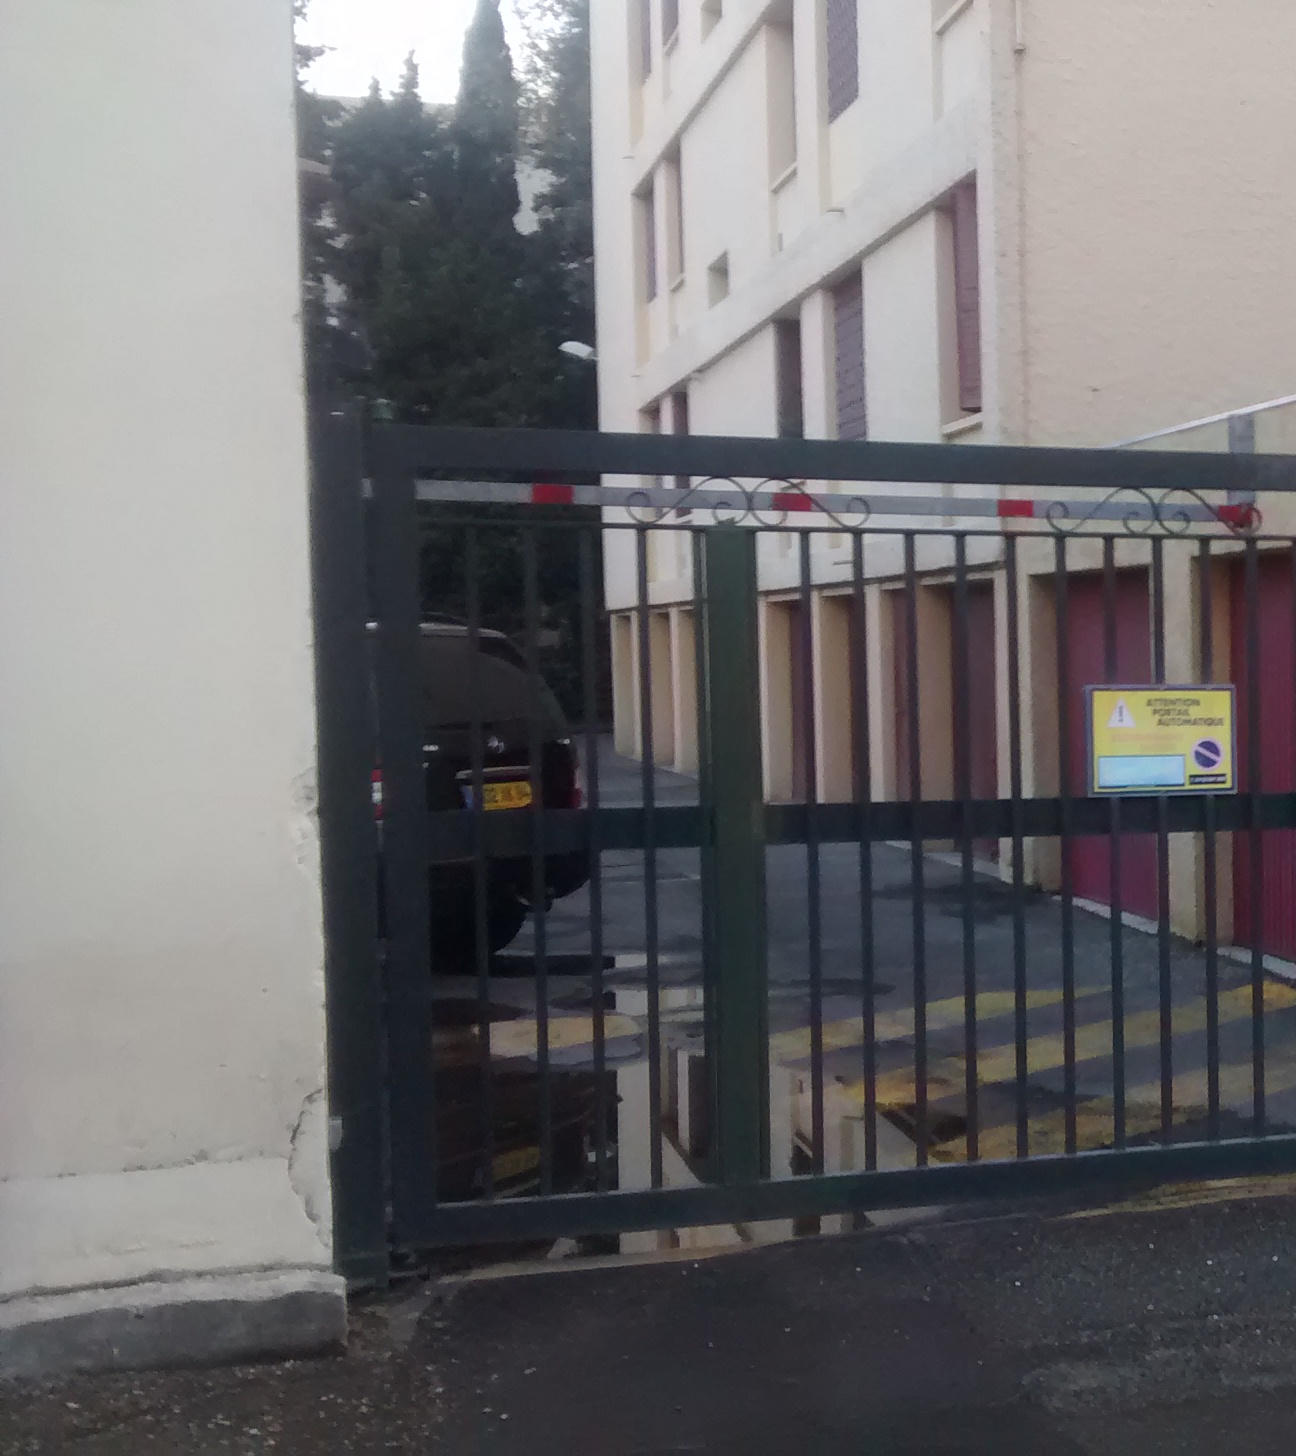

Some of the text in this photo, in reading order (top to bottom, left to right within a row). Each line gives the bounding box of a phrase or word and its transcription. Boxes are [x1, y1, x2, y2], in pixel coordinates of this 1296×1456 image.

[1146, 698, 1200, 707] ATTENTION
[1152, 708, 1190, 717] PORTAIL
[1157, 717, 1224, 726] AUTOMATIQUE
